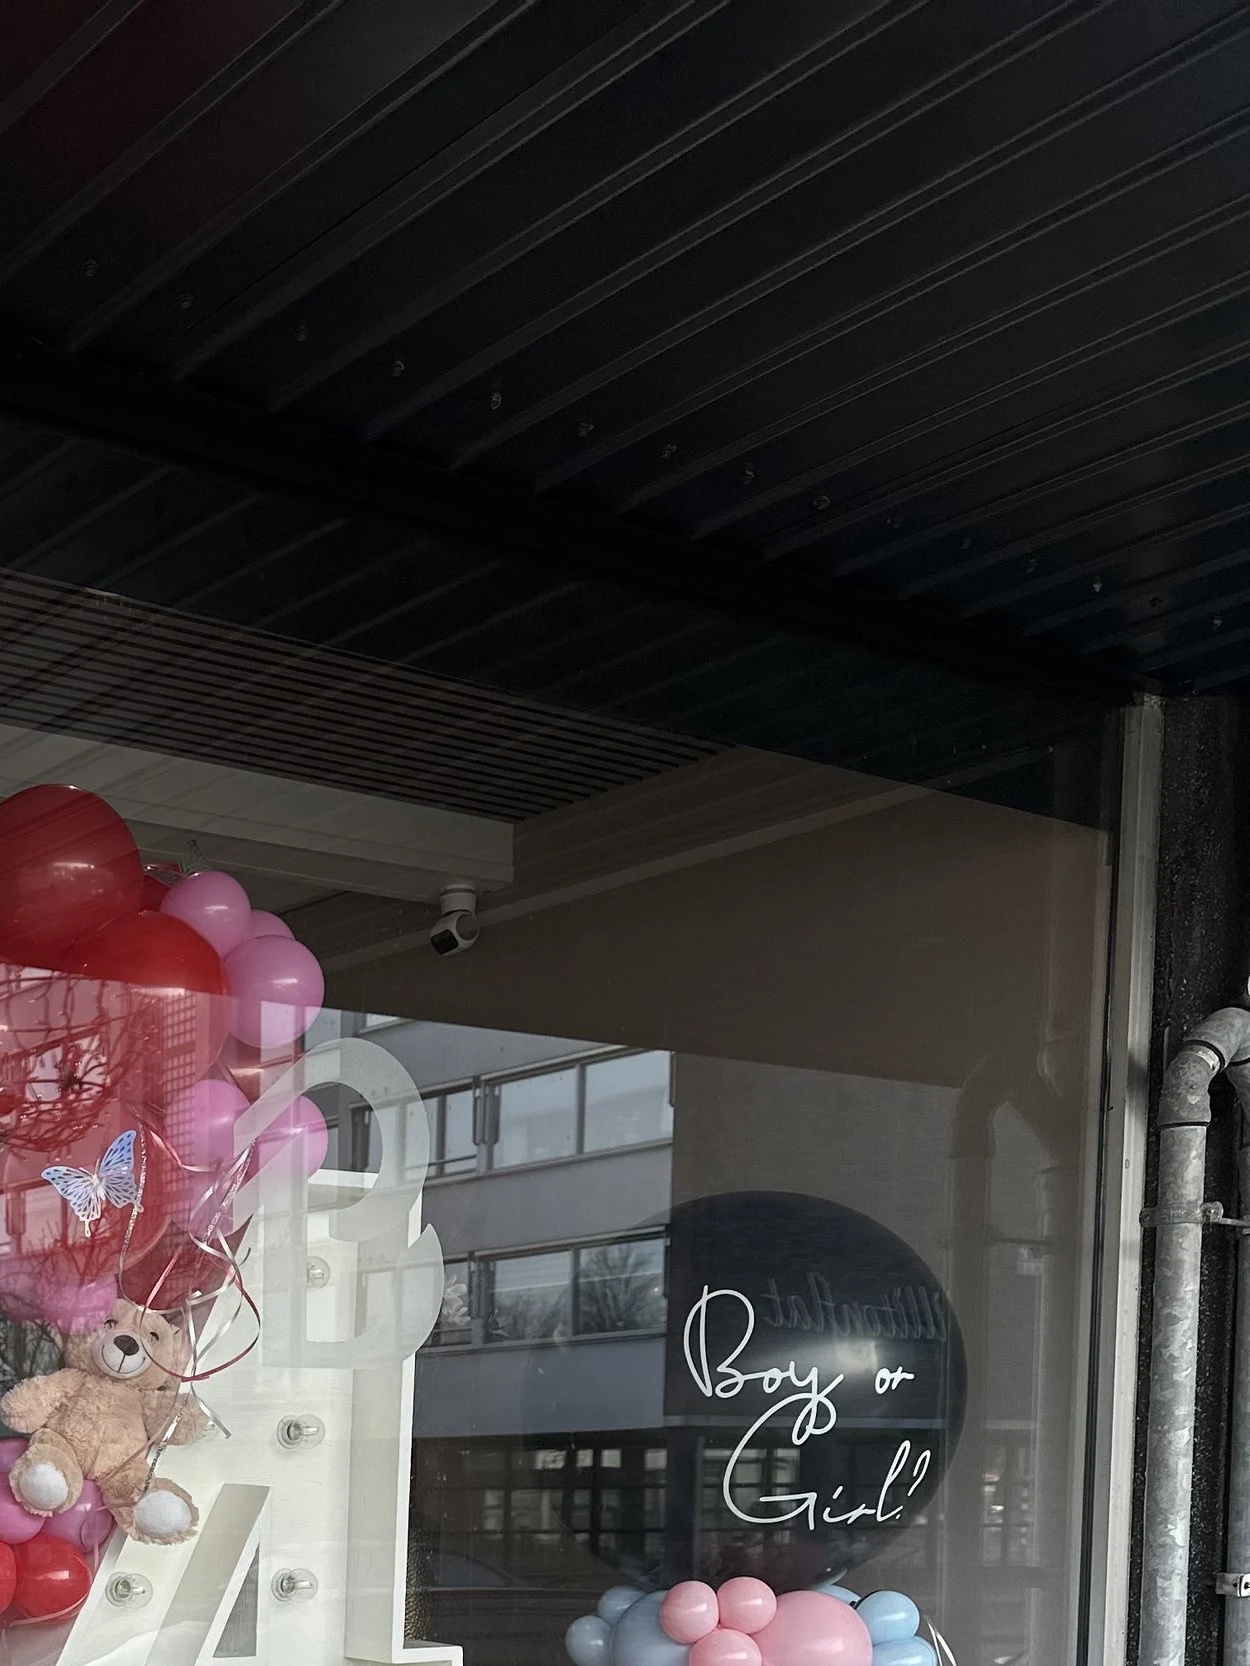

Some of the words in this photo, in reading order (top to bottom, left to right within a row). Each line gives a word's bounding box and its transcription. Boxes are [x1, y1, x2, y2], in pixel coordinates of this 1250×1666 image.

[683, 1284, 844, 1445] Boy
[875, 1366, 914, 1394] or
[722, 1392, 931, 1531] Girl?
